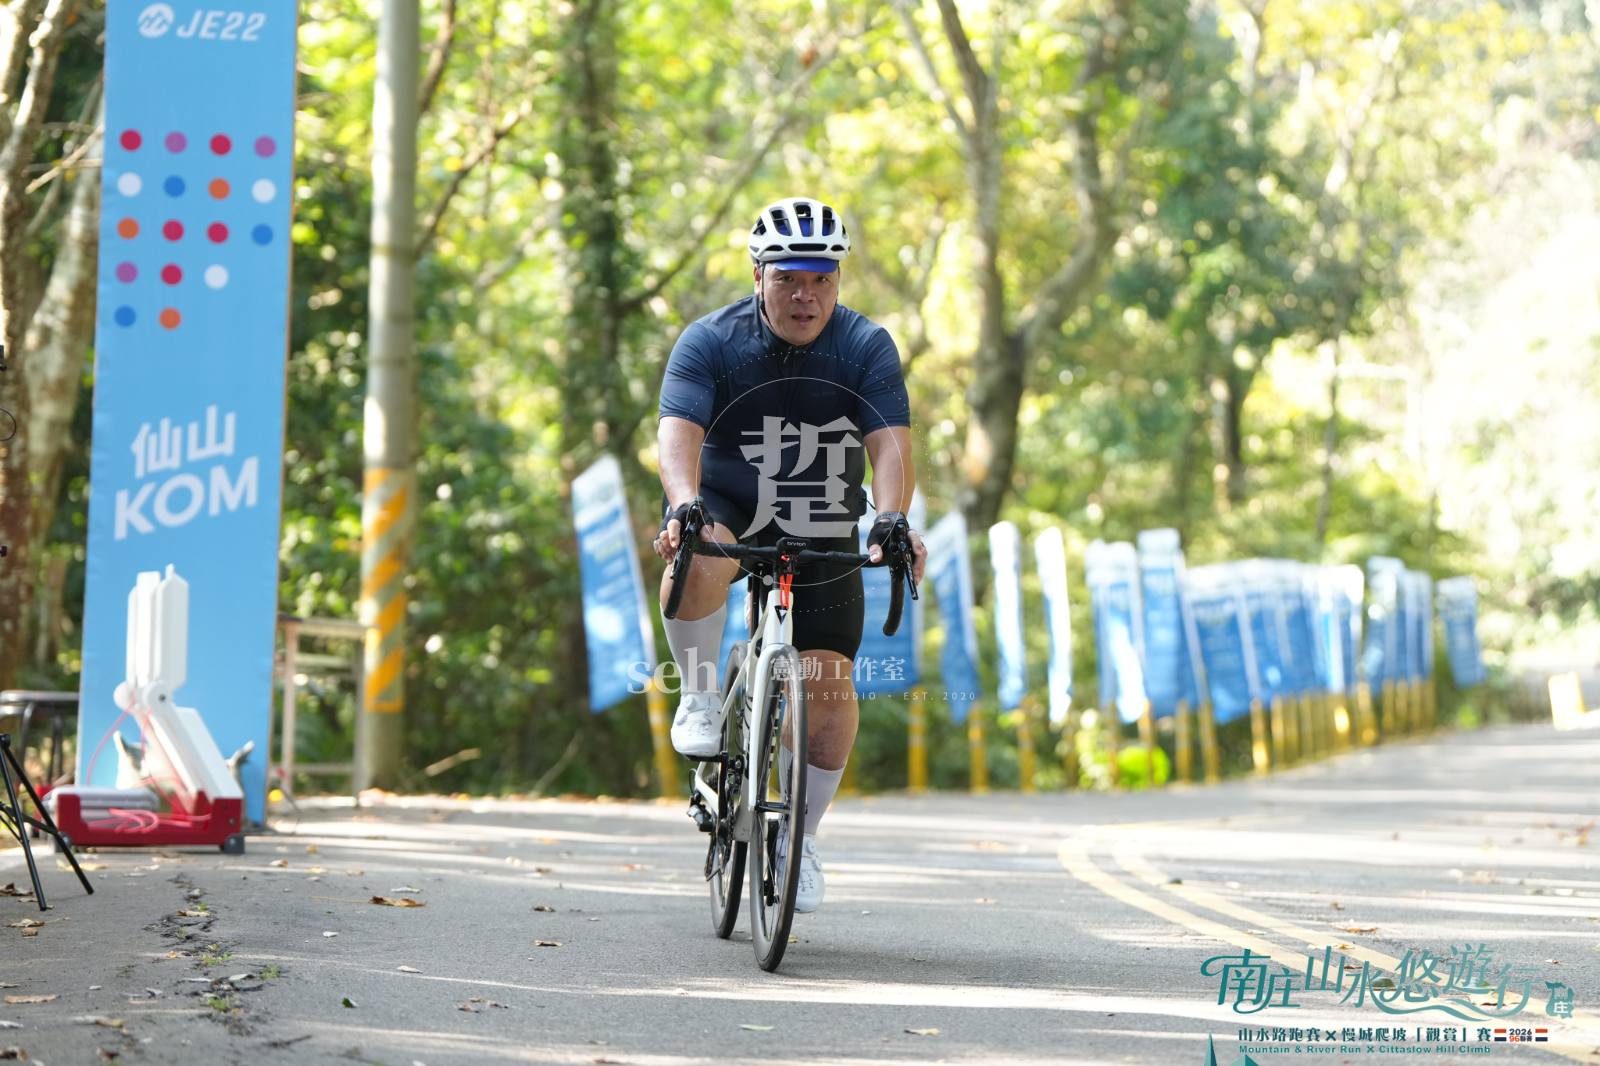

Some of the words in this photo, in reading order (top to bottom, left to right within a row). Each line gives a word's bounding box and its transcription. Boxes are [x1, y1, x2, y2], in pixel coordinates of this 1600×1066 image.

[176, 9, 267, 41] JE22
[130, 404, 236, 479] 仙山
[114, 455, 259, 541] KOM
